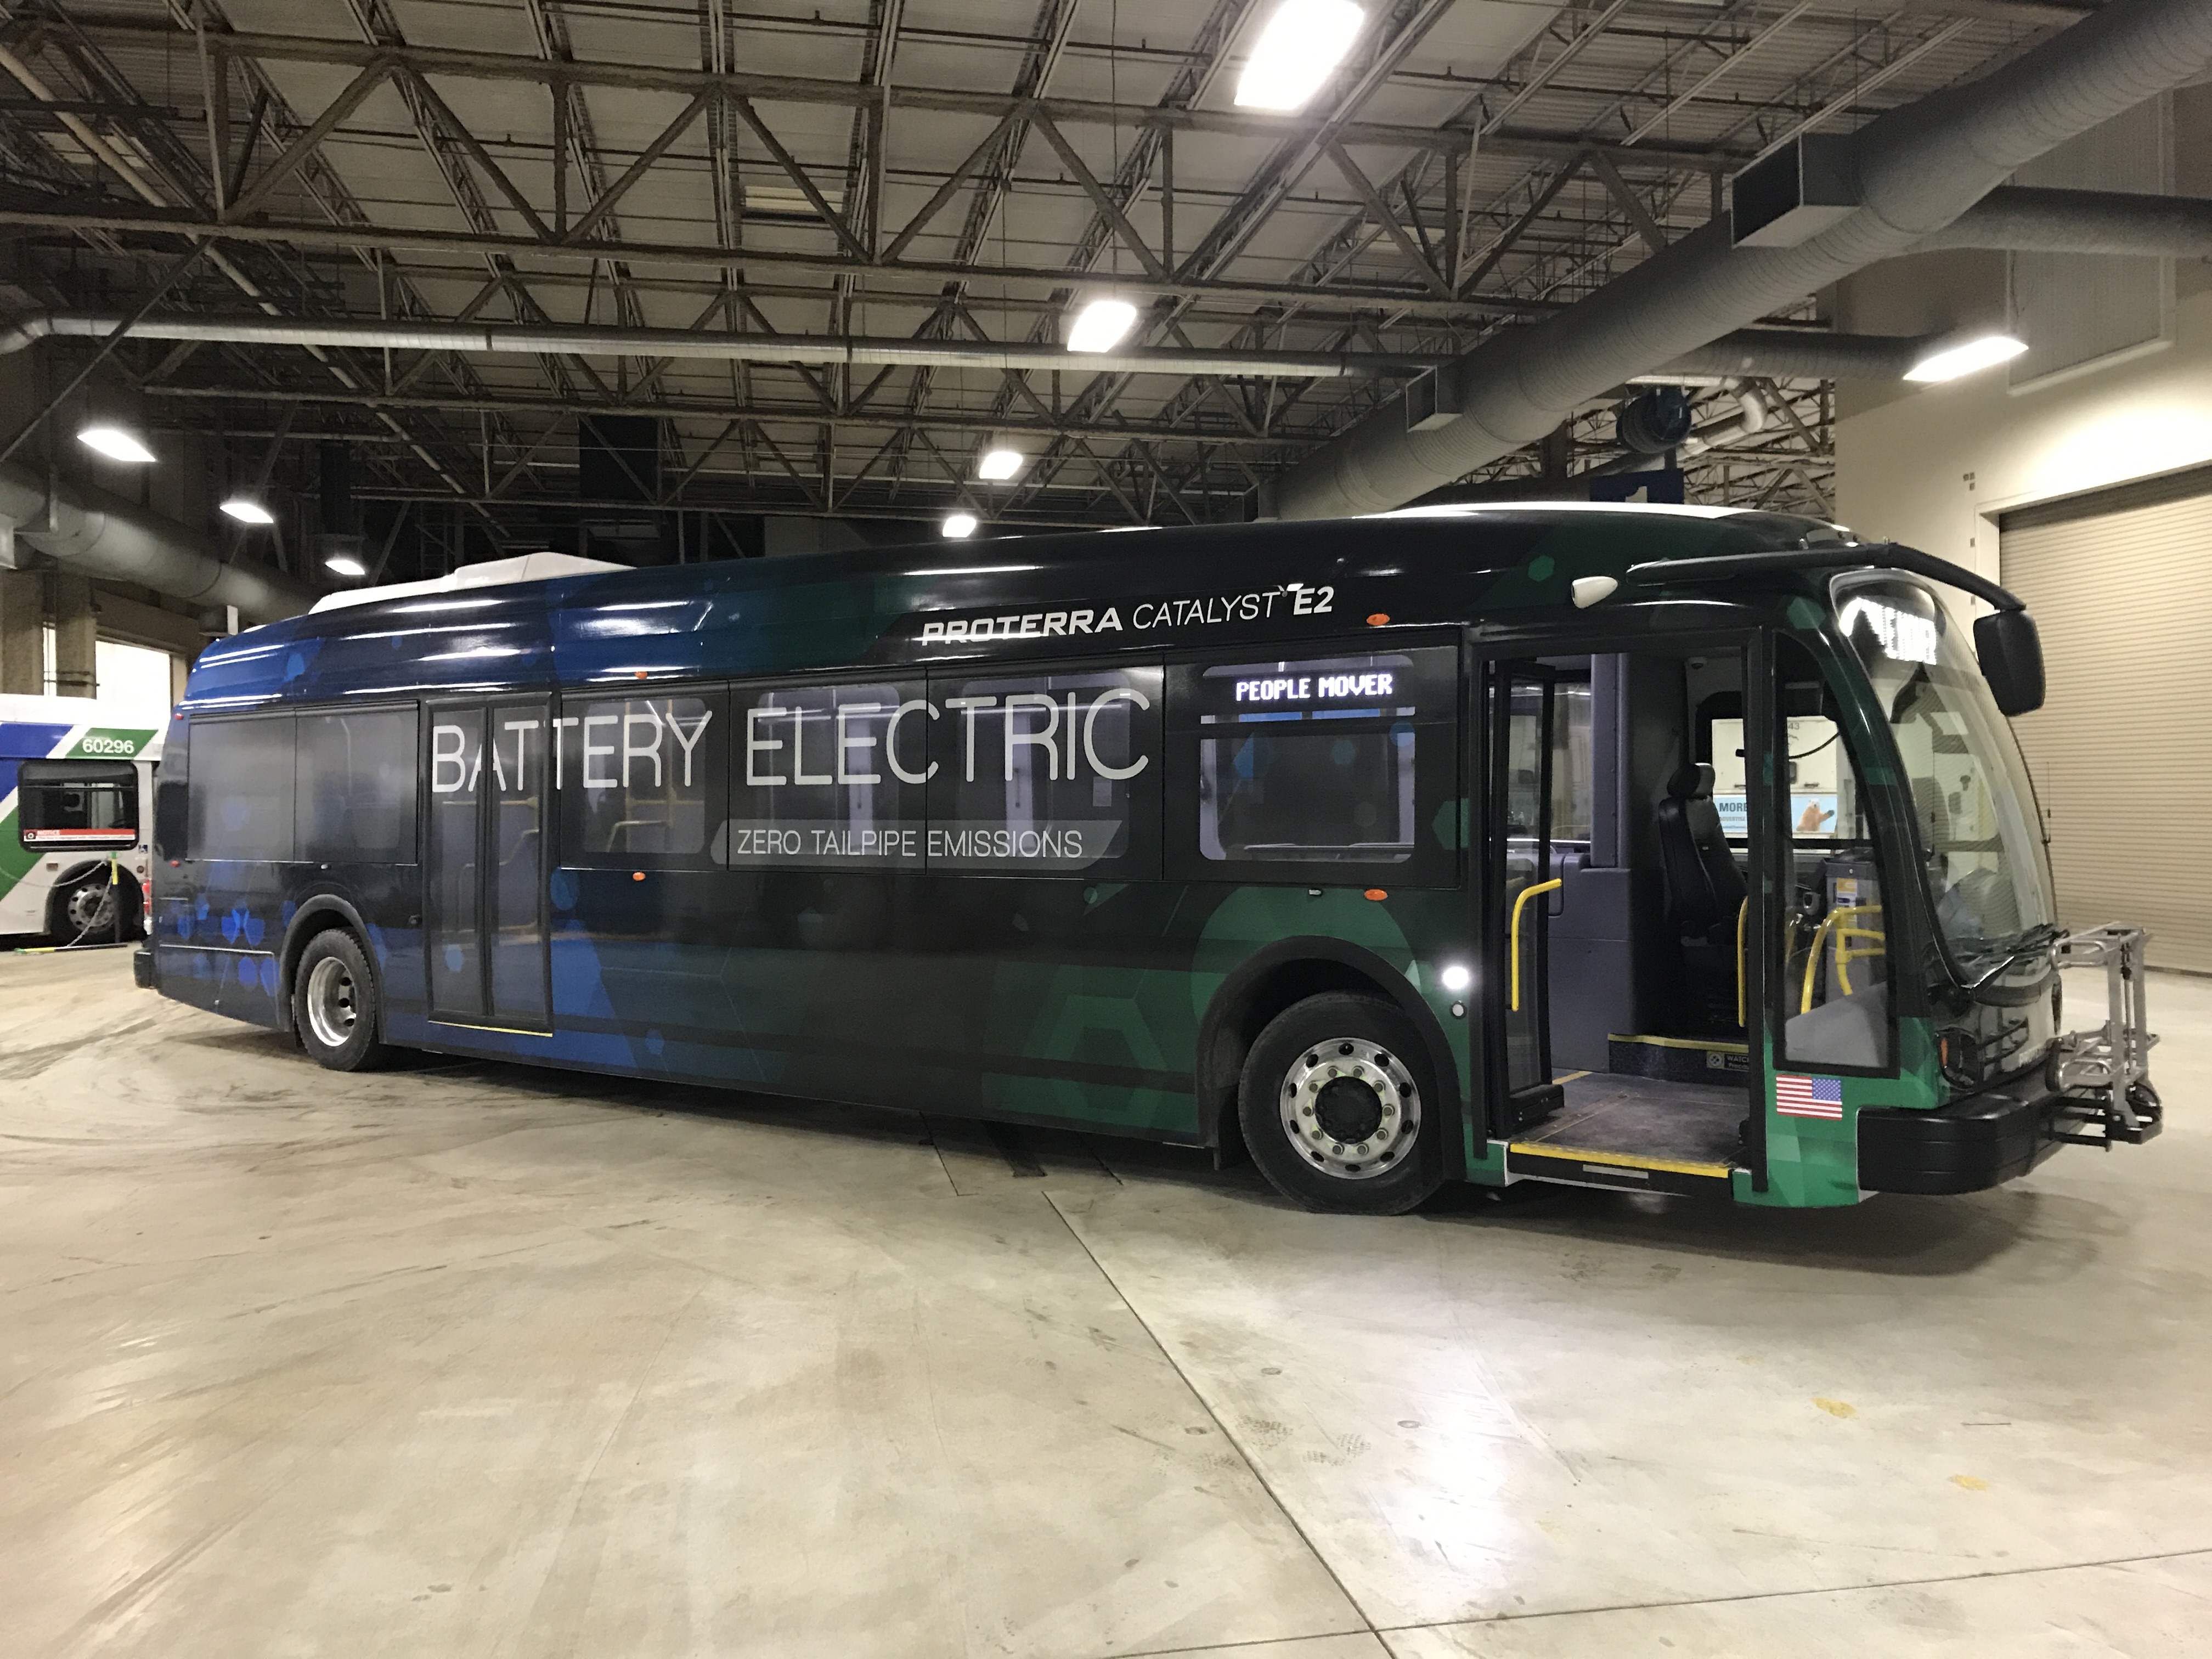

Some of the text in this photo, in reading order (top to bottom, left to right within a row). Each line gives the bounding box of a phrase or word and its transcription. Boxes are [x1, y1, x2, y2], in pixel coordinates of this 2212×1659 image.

[922, 586, 1334, 646] PROTERRA CATALYST E2
[1236, 674, 1392, 701] PEOPLE MOVER
[82, 738, 134, 754] 60296
[432, 688, 1150, 793] BATTERY ELECTRIC
[737, 830, 1082, 858] ZERO TAILPIPE EMISSIONS
